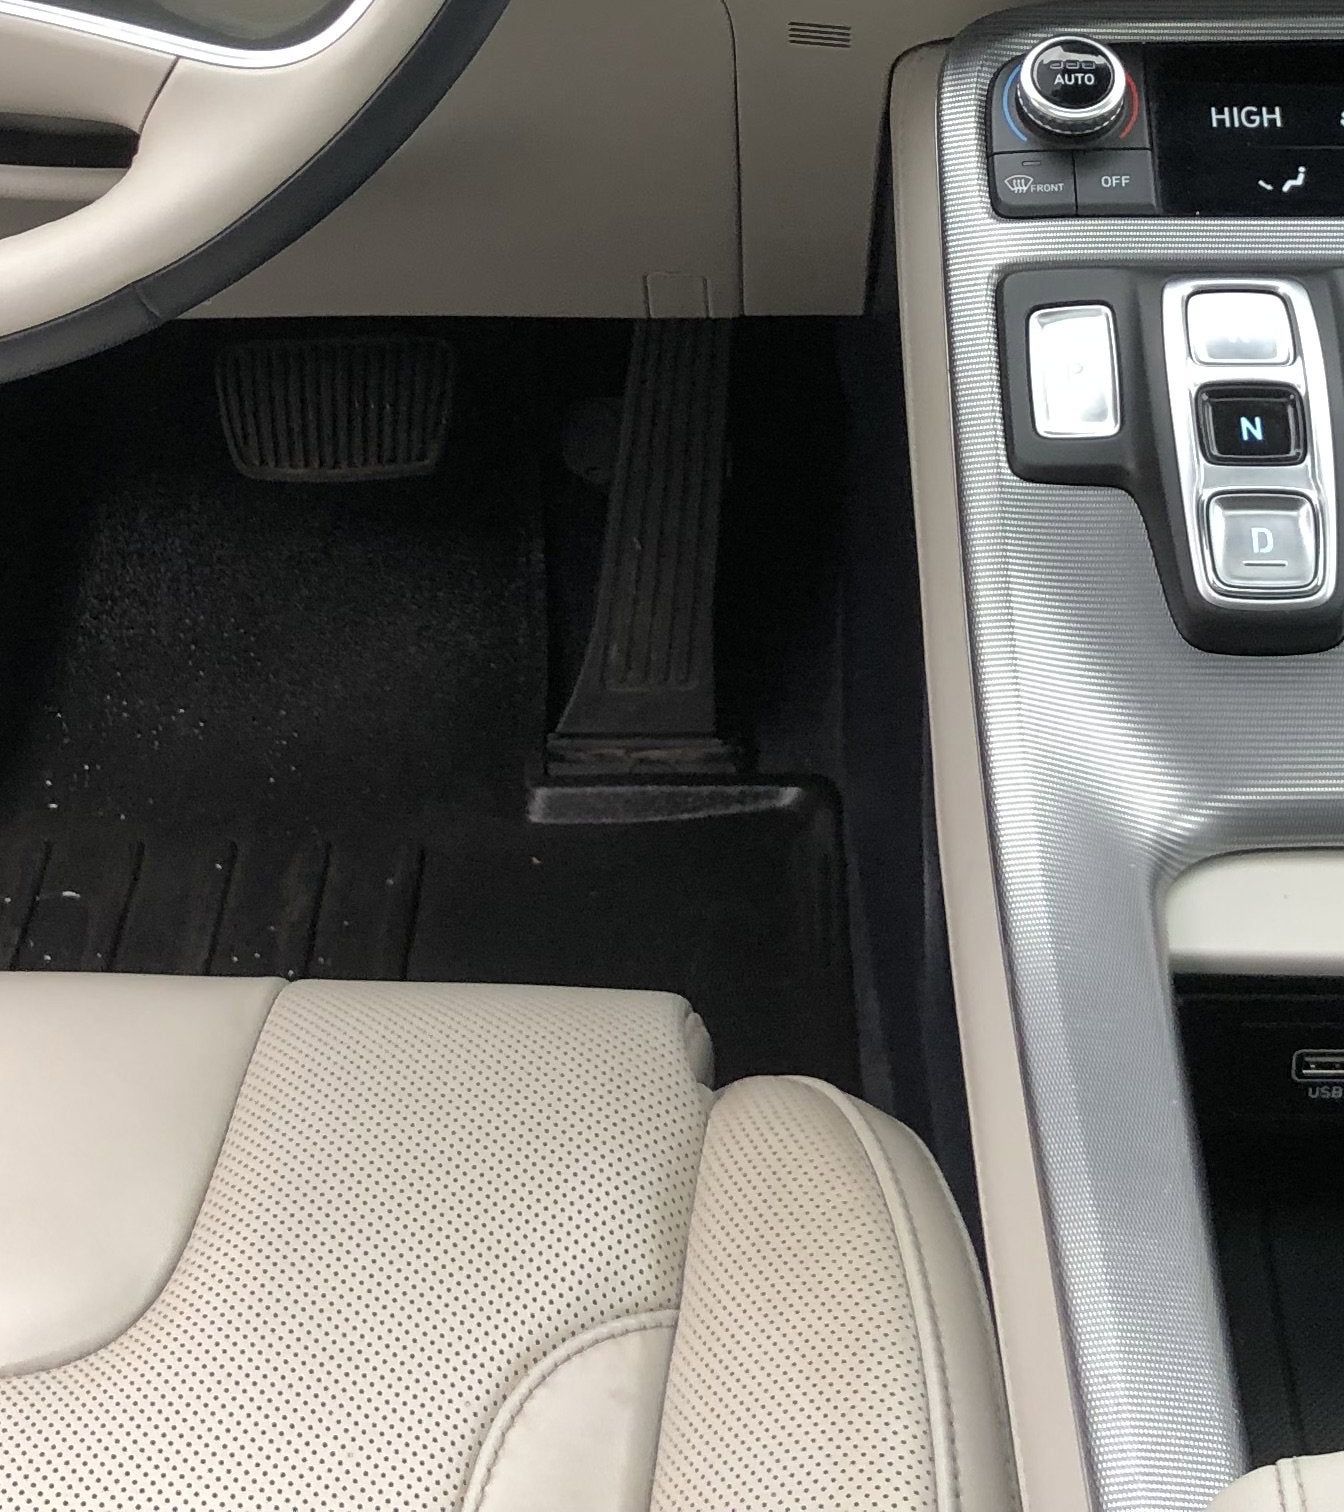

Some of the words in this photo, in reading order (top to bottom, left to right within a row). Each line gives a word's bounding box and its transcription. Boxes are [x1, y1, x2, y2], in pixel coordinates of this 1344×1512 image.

[1054, 73, 1095, 86] AUTO
[1210, 106, 1283, 129] HIGH
[1030, 182, 1065, 193] FRONT
[1101, 175, 1131, 188] OFF
[1239, 415, 1264, 441] N
[1251, 527, 1275, 554] D
[1307, 1085, 1344, 1099] USB
